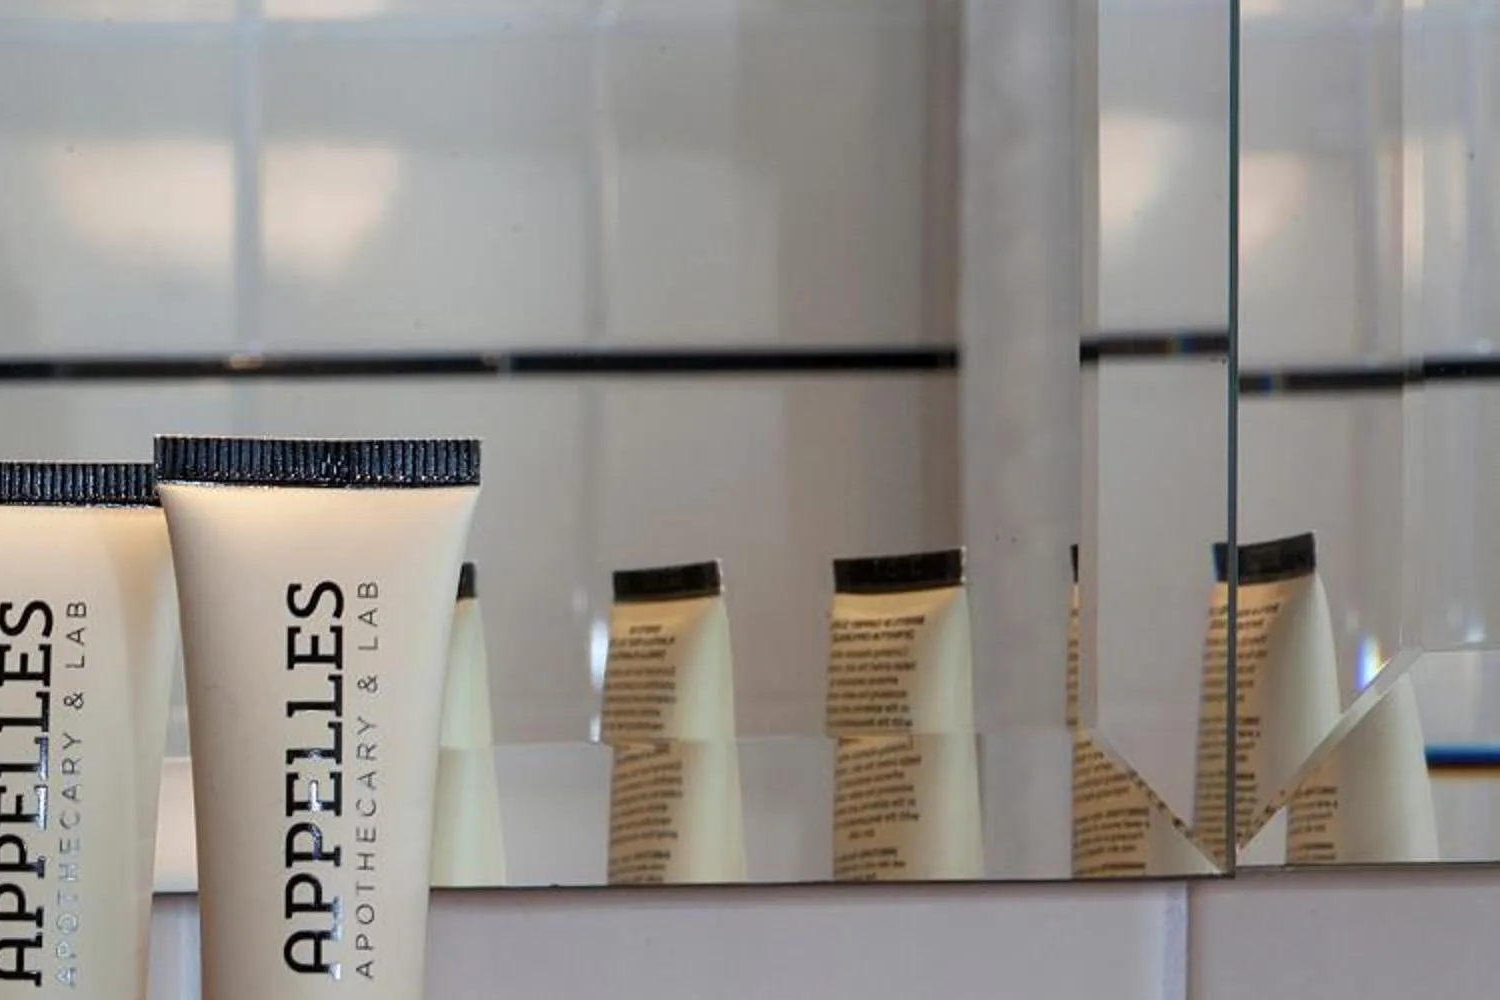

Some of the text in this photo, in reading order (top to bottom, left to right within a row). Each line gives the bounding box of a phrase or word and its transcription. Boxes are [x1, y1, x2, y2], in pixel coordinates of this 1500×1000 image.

[55, 601, 87, 988] APOTHECARY & LAB
[284, 581, 344, 981] APPELLES
[356, 581, 379, 979] APOTHECARY & LAB
